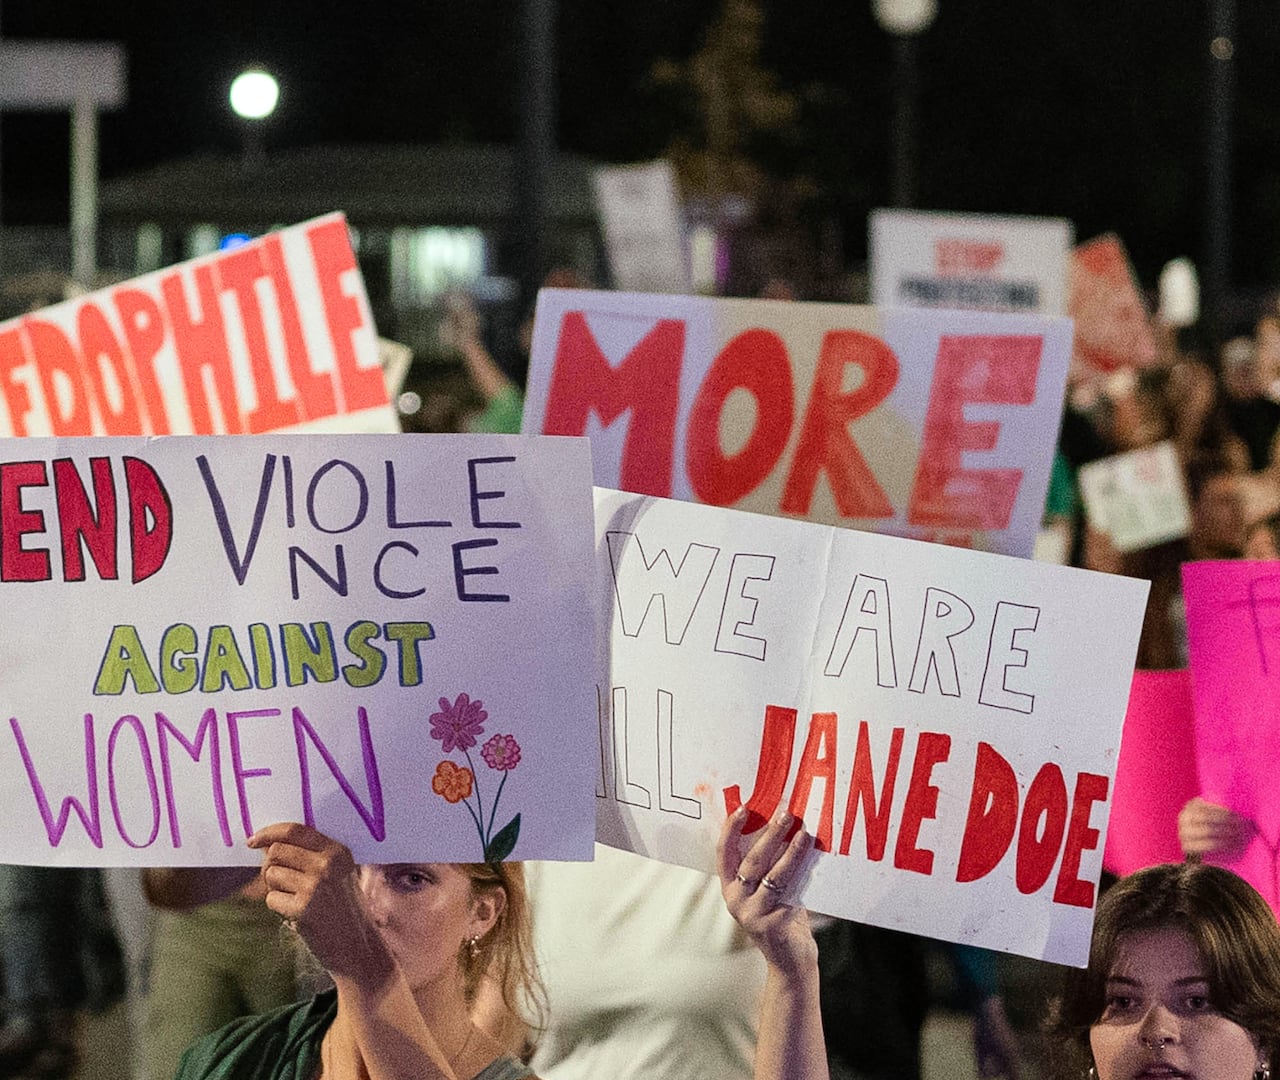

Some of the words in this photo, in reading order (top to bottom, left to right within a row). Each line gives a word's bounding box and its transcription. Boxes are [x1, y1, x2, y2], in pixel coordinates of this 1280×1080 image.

[542, 311, 1044, 530] MORE
[92, 620, 436, 696] AGAINST
[606, 531, 776, 661] WE
[823, 573, 1041, 715] ARE
[10, 705, 387, 849] WOMEN
[595, 684, 701, 820] LL
[723, 704, 951, 876] JANE
[955, 741, 1110, 909] DOE
